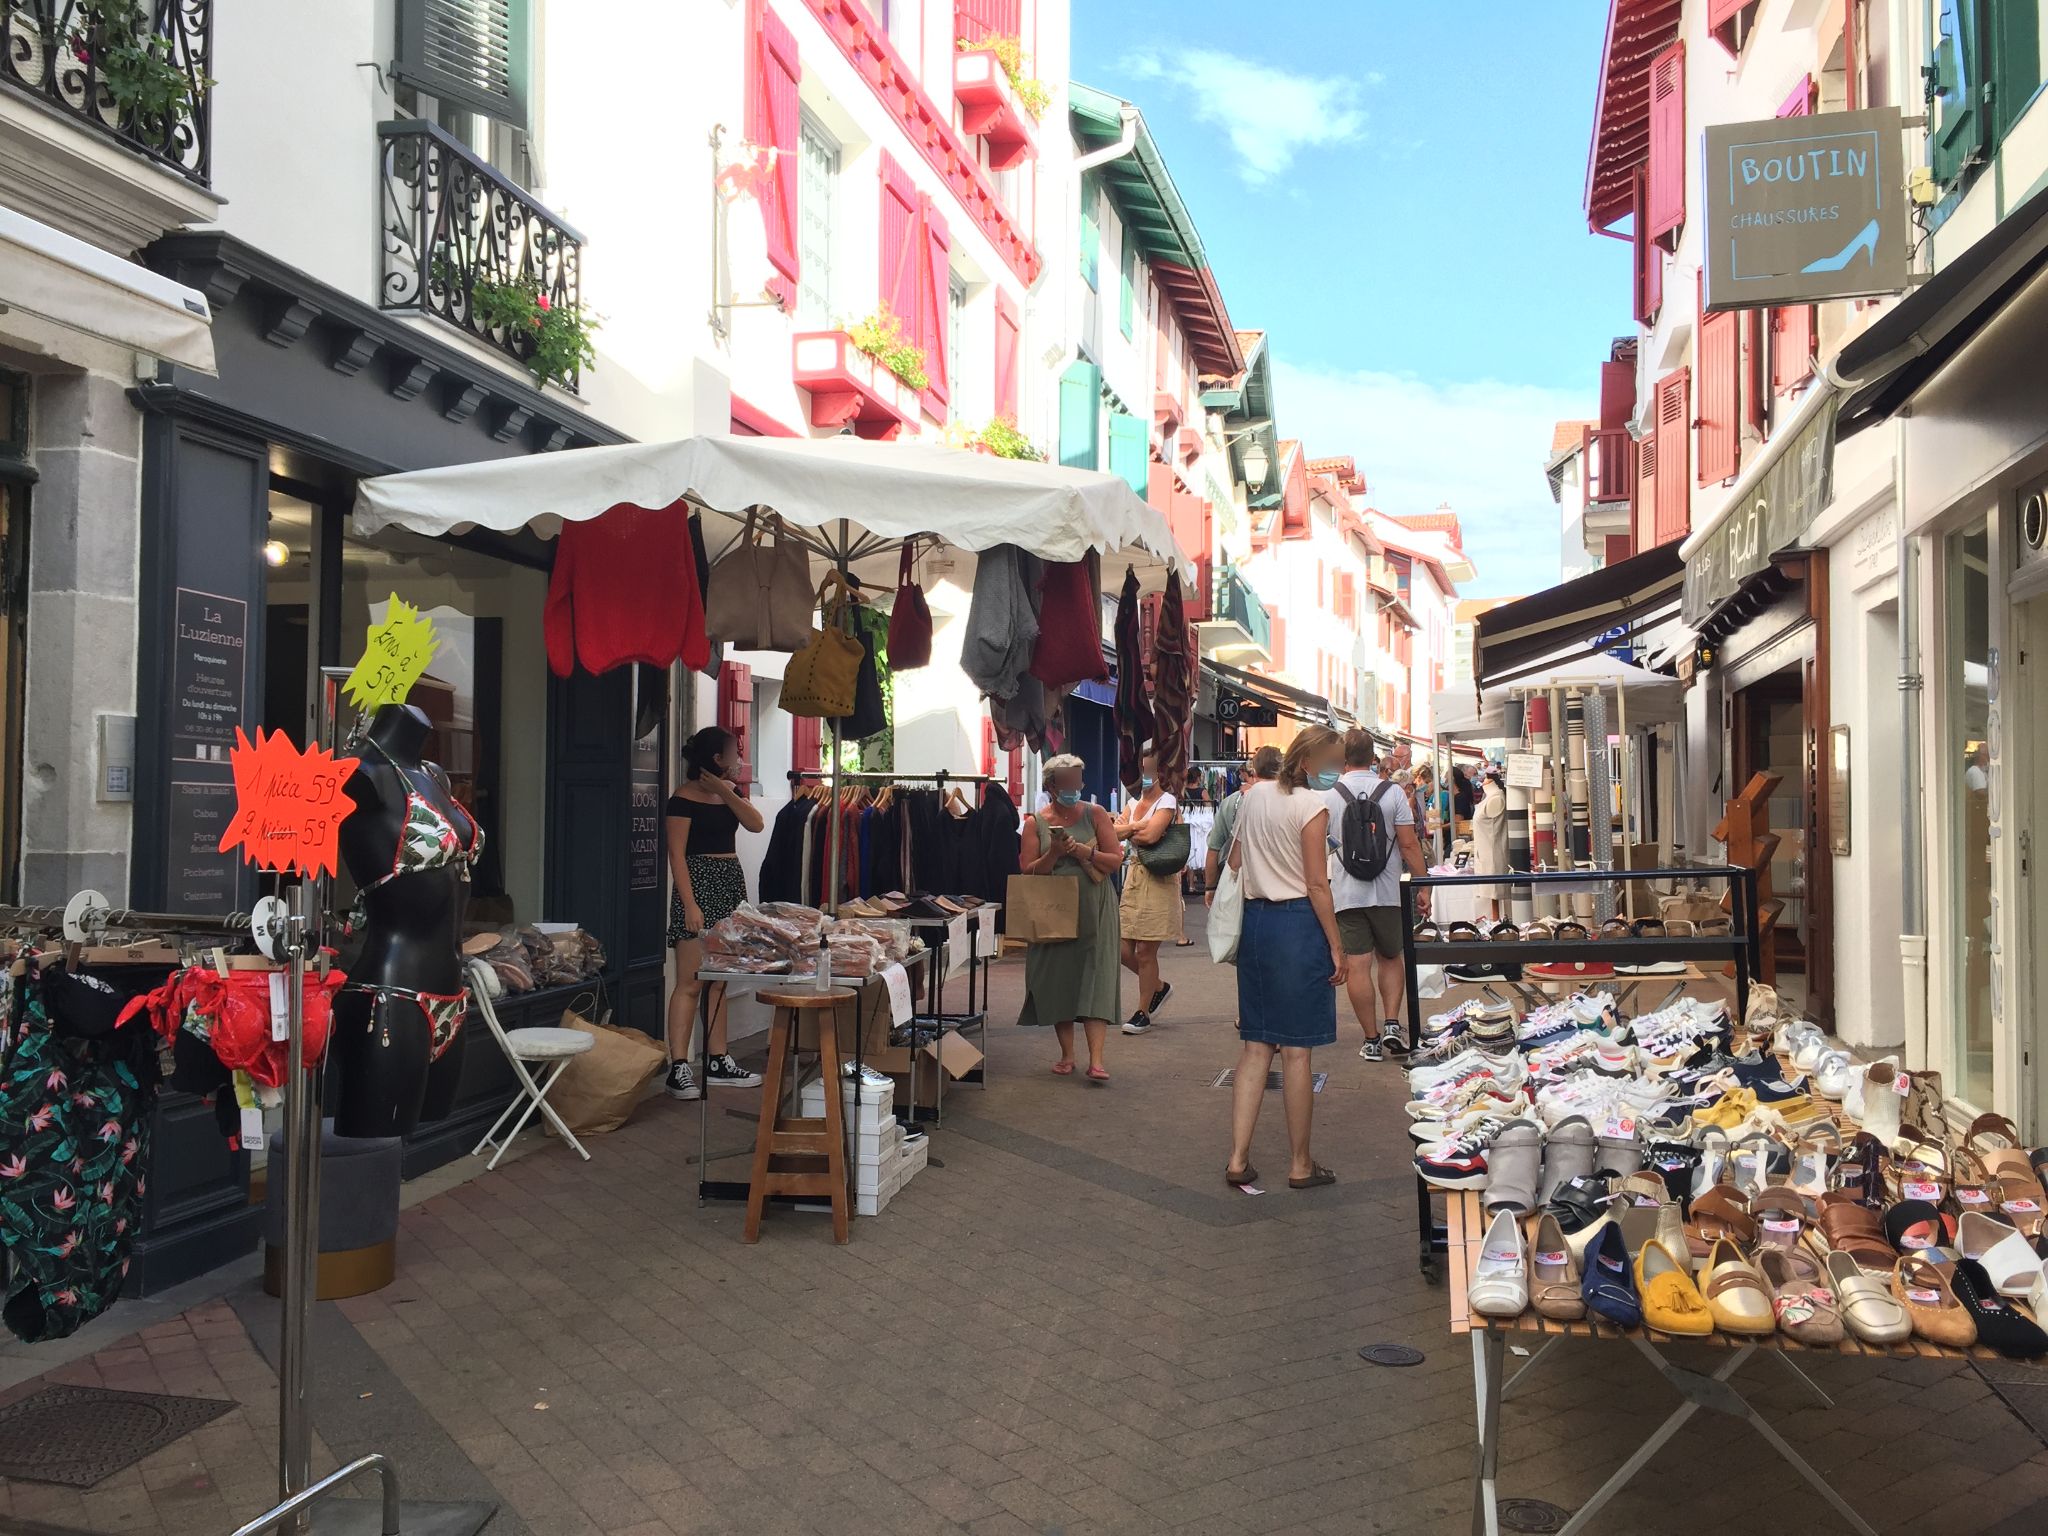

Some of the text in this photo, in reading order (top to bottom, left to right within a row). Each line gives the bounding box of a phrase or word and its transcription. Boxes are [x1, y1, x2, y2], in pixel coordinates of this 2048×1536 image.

[1741, 148, 1868, 185] BOUTIN
[1730, 205, 1840, 229] CHAUSSURES
[203, 607, 222, 623] La
[180, 623, 243, 647] Luzienne
[182, 698, 191, 708] Du
[213, 702, 237, 713] dimanche
[246, 764, 263, 796] 1
[632, 792, 657, 808] 100%
[241, 810, 255, 834] 2
[632, 817, 656, 832] FAIT
[631, 840, 657, 852] MAIN
